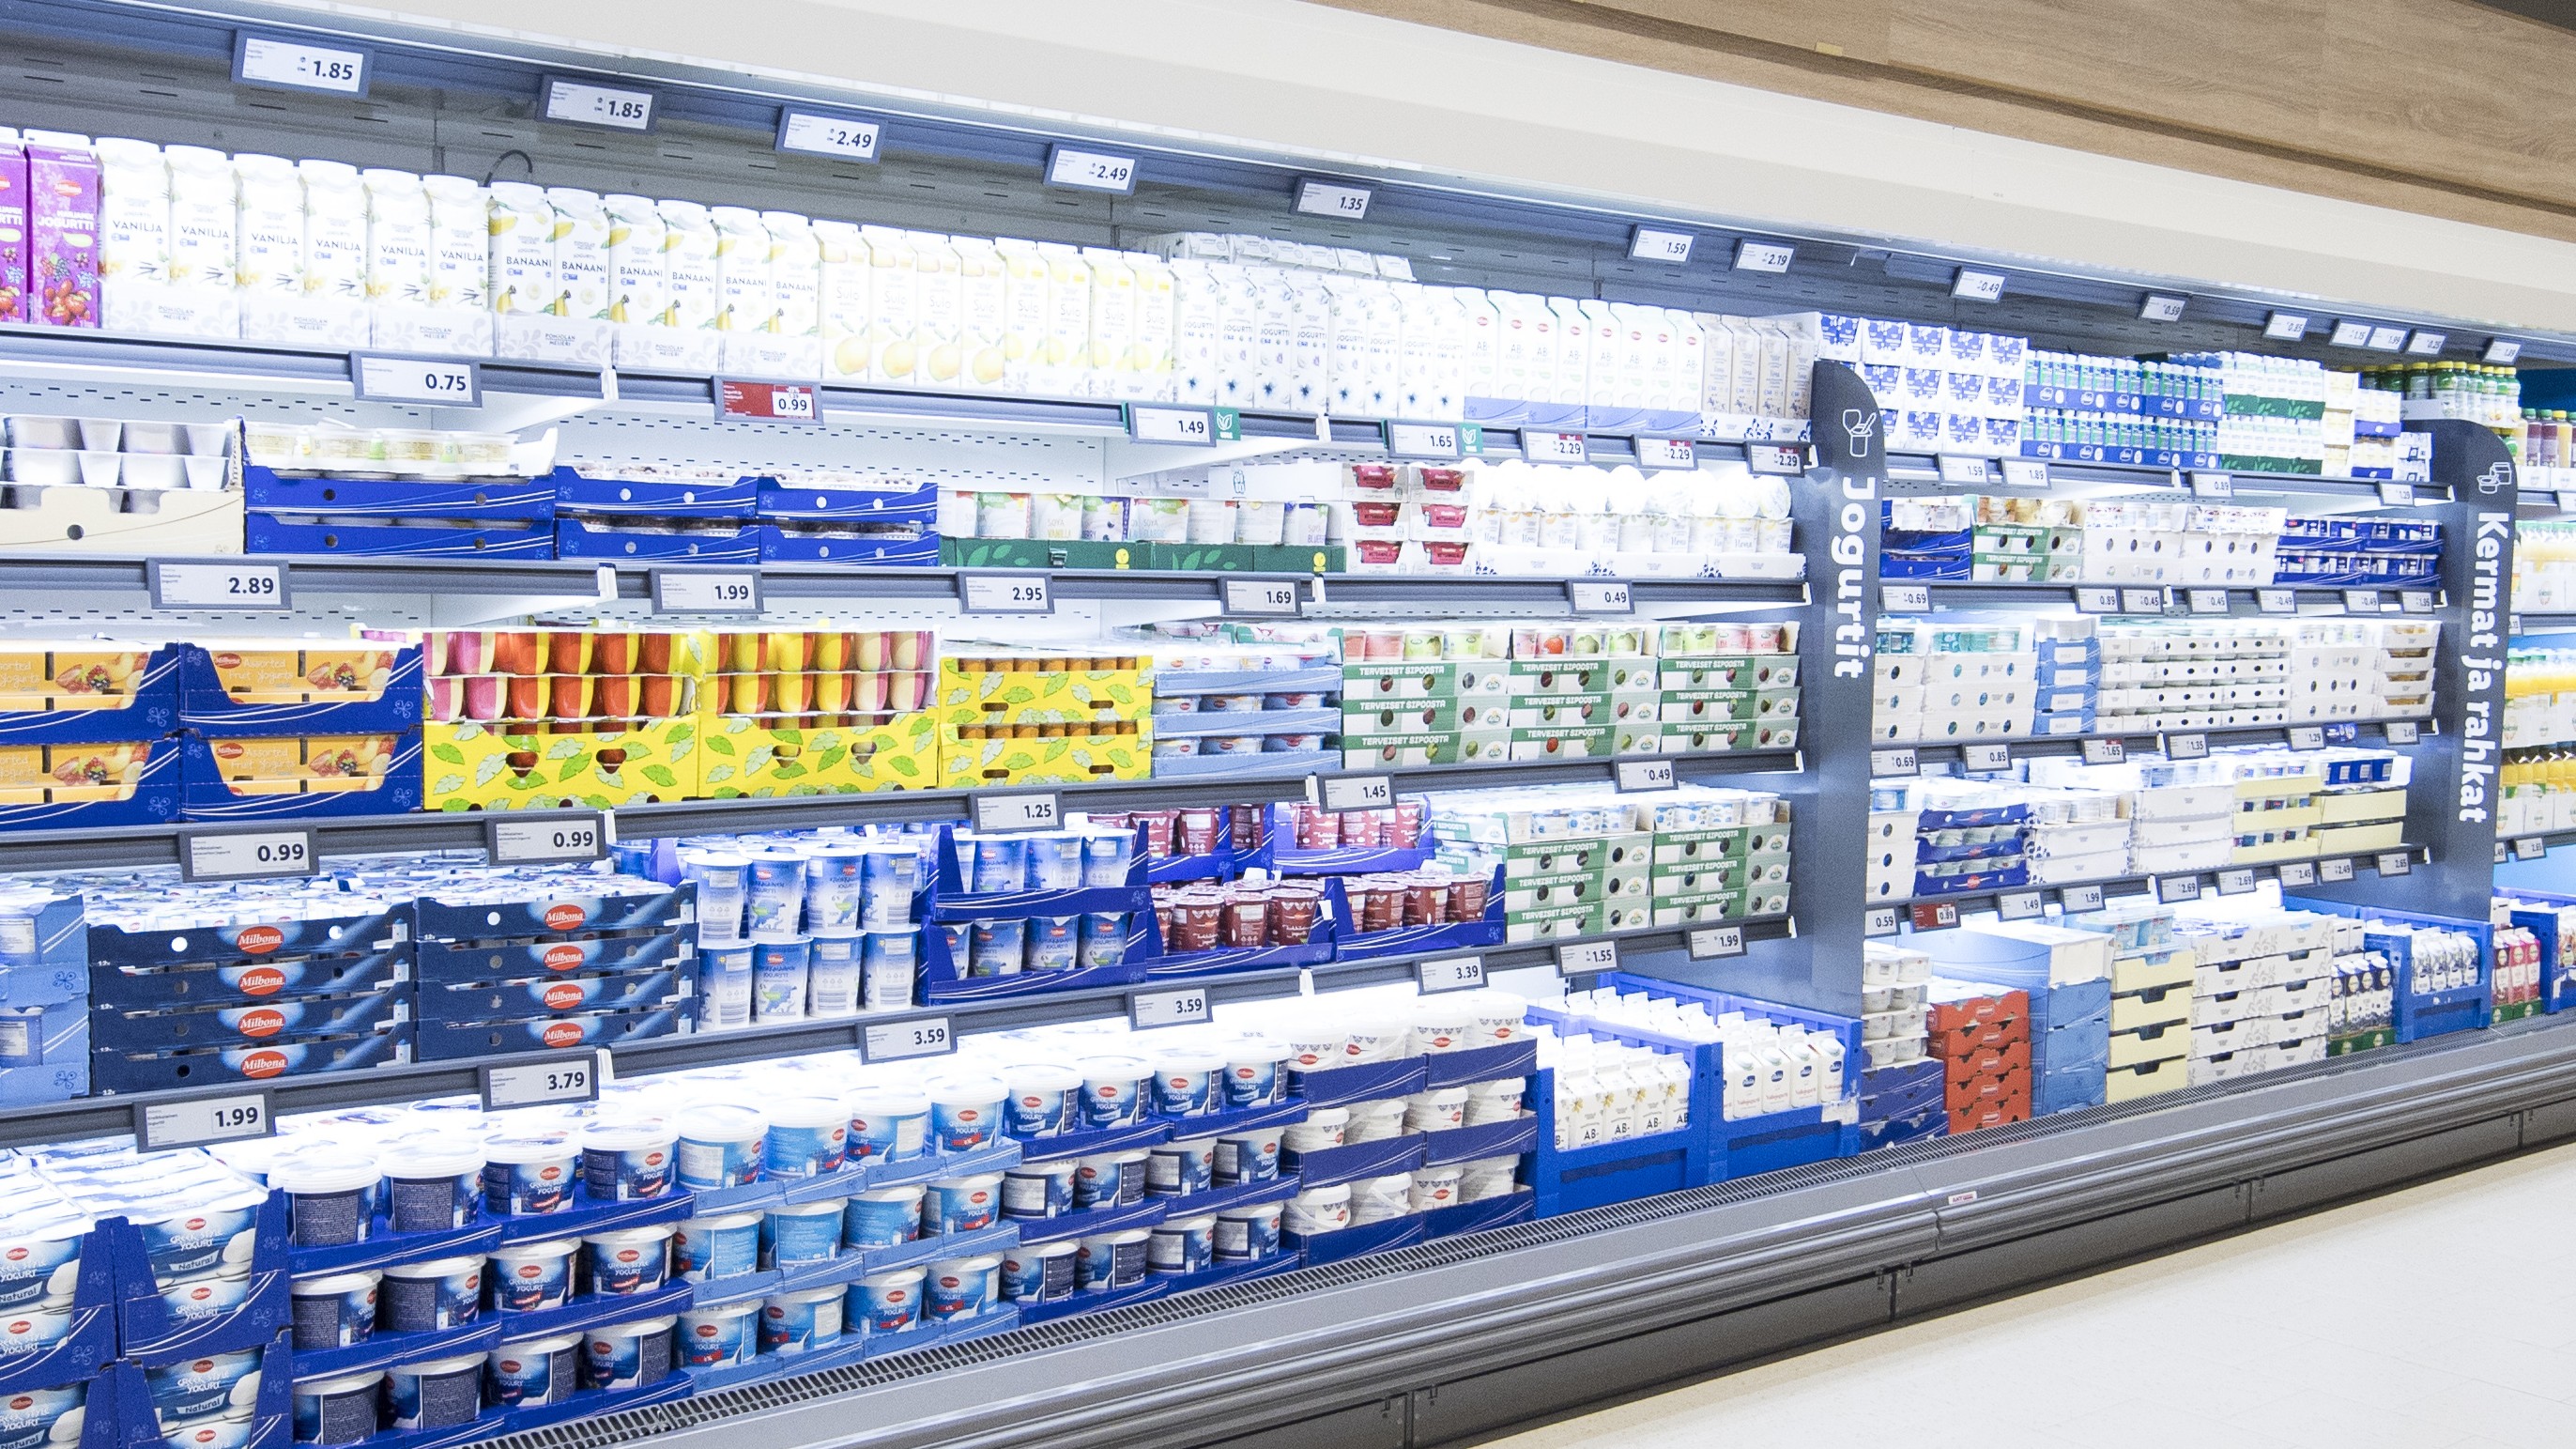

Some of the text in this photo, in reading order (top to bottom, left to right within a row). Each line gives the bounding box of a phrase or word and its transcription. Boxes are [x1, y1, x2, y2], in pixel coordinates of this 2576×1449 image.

[313, 59, 354, 81] 1.85
[606, 100, 645, 120] 1.85
[836, 130, 873, 148] 2.49
[1096, 164, 1128, 182] 2.49
[1339, 195, 1363, 211] 1.35
[38, 215, 95, 231] JOGURTTI
[113, 221, 162, 233] VANILJA
[181, 226, 229, 239] VANILJA
[252, 233, 298, 246] VANILJA
[315, 240, 360, 252] VANILJA
[381, 246, 425, 257] VANILJA
[1665, 241, 1687, 255] 1.59
[440, 250, 483, 261] VANILJA
[506, 256, 552, 267] BANAANI
[1767, 254, 1787, 267] 2.19
[561, 261, 606, 272] BANAANI
[621, 267, 663, 277] BANAANI
[672, 271, 713, 283] BANAANI
[726, 276, 767, 286] BANAANI
[775, 281, 816, 292] BANAANI
[1261, 328, 1290, 336] JOGURTTI
[1297, 331, 1326, 340] JOGURTTI
[424, 373, 468, 392] 0.75
[777, 397, 808, 411] 0.99
[1178, 420, 1204, 434] 1.49
[1429, 435, 1452, 448] 1.65
[1558, 440, 1582, 455] 2.29
[1669, 447, 1691, 461] 2.29
[1778, 454, 1799, 468] 2.29
[1967, 465, 1984, 477] 1.59
[1831, 476, 1876, 679] Jogurtit
[227, 577, 274, 594] 2.89
[713, 585, 750, 601] 1.99
[1011, 587, 1043, 601] 2.95
[1265, 590, 1292, 605] 1.69
[1603, 591, 1627, 603] 0.49
[1908, 593, 1927, 605] 0.69
[2099, 594, 2116, 606] 0.89
[244, 658, 285, 669] Assorted
[1523, 662, 1598, 671] TERVEISET SIPOOSTA
[1675, 660, 1744, 669] TERVEISET SIPOOSTA
[2459, 512, 2508, 825] Kermat ja rahkat
[1359, 666, 1444, 676] TERVEISET SIPOOSTA
[1525, 696, 1602, 705] TERVEISET SIPOOSTA
[1677, 691, 1747, 700] TERVEISET SIPOOSTA
[1360, 700, 1446, 710] TERVEISET SIPOOSTA
[1527, 728, 1605, 738] TERVEISET SIPOOSTA
[1677, 723, 1747, 732] TERVEISET SIPOOSTA
[1362, 736, 1449, 746] TERVEISET SIPOOSTA
[246, 748, 288, 757] Assorted
[1989, 751, 2007, 763] 0.85
[1894, 755, 1915, 768] 0.69
[1648, 768, 1671, 781] 0.49
[1362, 785, 1387, 800] 1.45
[1023, 802, 1052, 821] 1.25
[552, 830, 594, 849] 0.99
[1669, 829, 1739, 841] TERVEISET SIPOOSTA
[256, 843, 304, 863] 0.99
[1523, 842, 1598, 855] TERVEISET SIPOOSTA
[1667, 861, 1737, 873] TERVEISET SIPOOSTA
[1519, 873, 1593, 886] TERVEISET SIPOOSTA
[2180, 882, 2197, 894] 2.69
[1670, 892, 1737, 904] TERVEISET SIPOOSTA
[2084, 892, 2101, 903] 1.99
[2023, 899, 2040, 910] 1.49
[545, 910, 585, 922] Milbona
[1522, 905, 1594, 920] TERVEISET SIPOOSTA
[1875, 916, 1894, 928] 0.59
[238, 932, 284, 946] Milbona
[1719, 933, 1740, 948] 1.99
[544, 950, 583, 963] Milbona
[1591, 949, 1613, 963] 1.55
[1455, 963, 1480, 980] 3.39
[240, 974, 284, 987] Milbona
[545, 990, 582, 1002] Milbona
[1175, 997, 1204, 1014] 3.59
[240, 1015, 284, 1028] Milbona
[544, 1027, 582, 1041] Milbona
[913, 1027, 946, 1046] 3.59
[242, 1056, 286, 1070] Milbona
[546, 1071, 585, 1091] 3.79
[214, 1106, 259, 1128] 1.99
[1647, 1118, 1662, 1129] AB-
[1584, 1129, 1599, 1140] AB-
[1615, 1123, 1630, 1134] AB-
[642, 1170, 665, 1180] YOGURT
[537, 1185, 562, 1195] YOGURT
[180, 1240, 213, 1251] YOGURT
[178, 1256, 213, 1270] Natural
[0, 1287, 36, 1302] Natural
[516, 1284, 544, 1292] YOGURT
[186, 1308, 218, 1320] YOGURT
[3, 1342, 39, 1354] YOGURT
[188, 1382, 221, 1394] YOGURT
[185, 1398, 221, 1414] Natural
[3, 1418, 39, 1430] YOGURT
[0, 1435, 39, 1449] Natural
